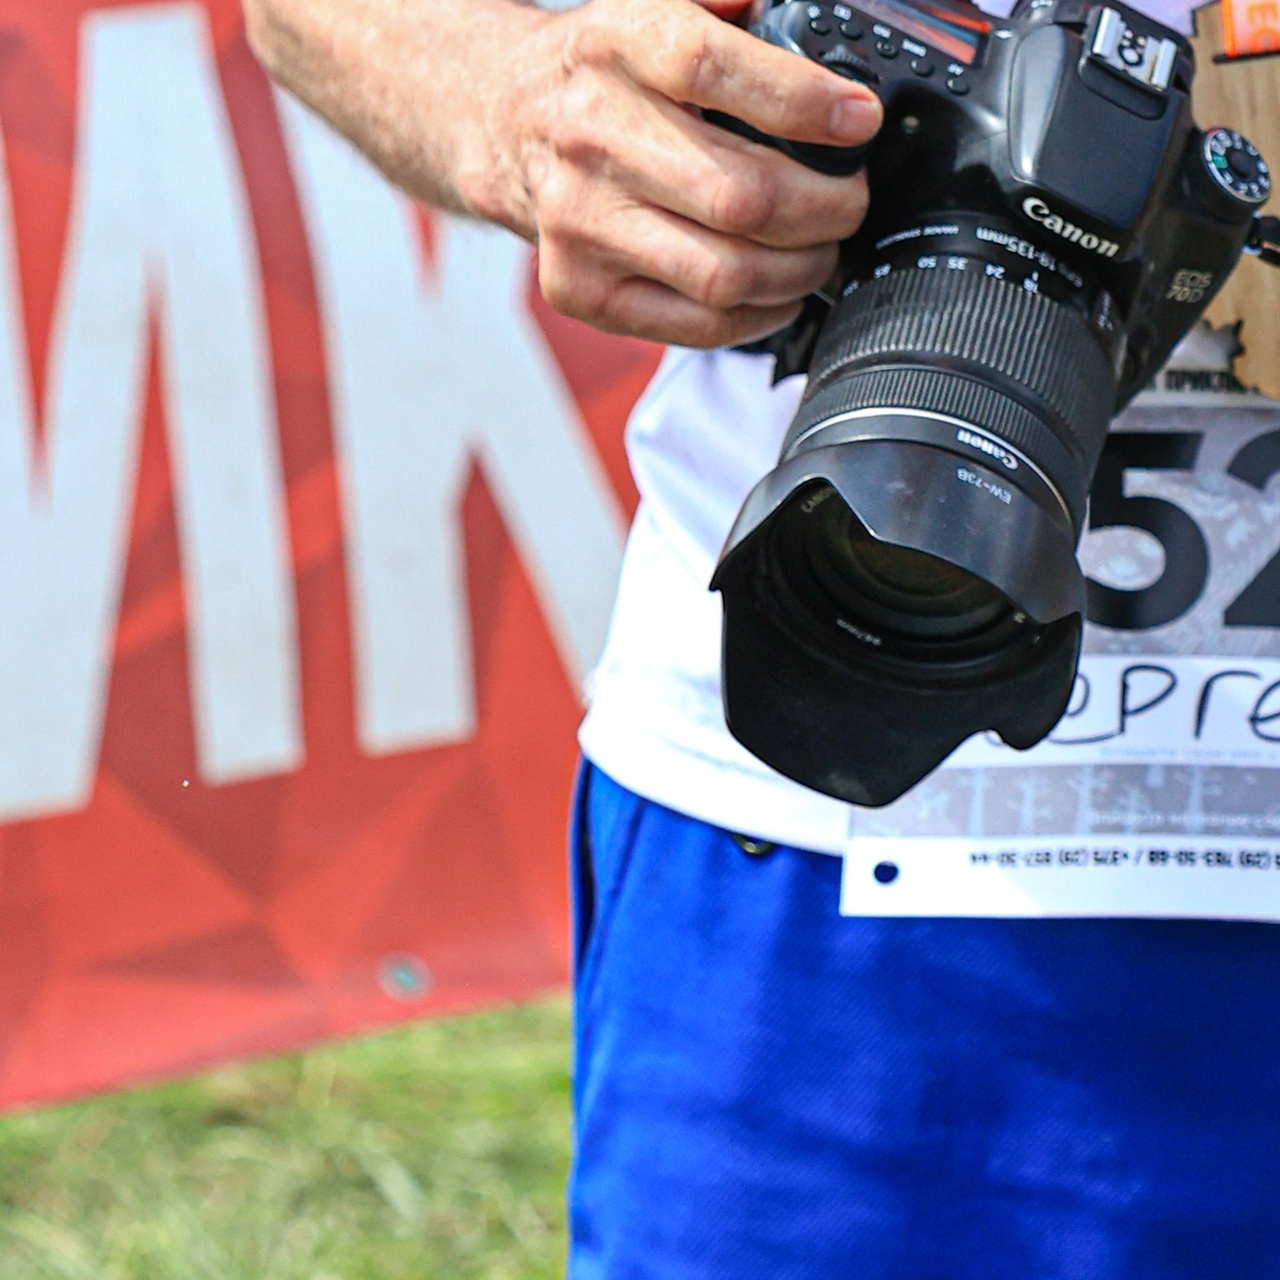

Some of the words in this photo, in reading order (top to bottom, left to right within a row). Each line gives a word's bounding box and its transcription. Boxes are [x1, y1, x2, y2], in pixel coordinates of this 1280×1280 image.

[1021, 196, 1121, 258] Canon
[917, 255, 937, 270] 50
[948, 256, 968, 271] 35
[985, 262, 1006, 279] 24
[957, 428, 1019, 470] Canon
[957, 466, 1013, 506] EW-73B
